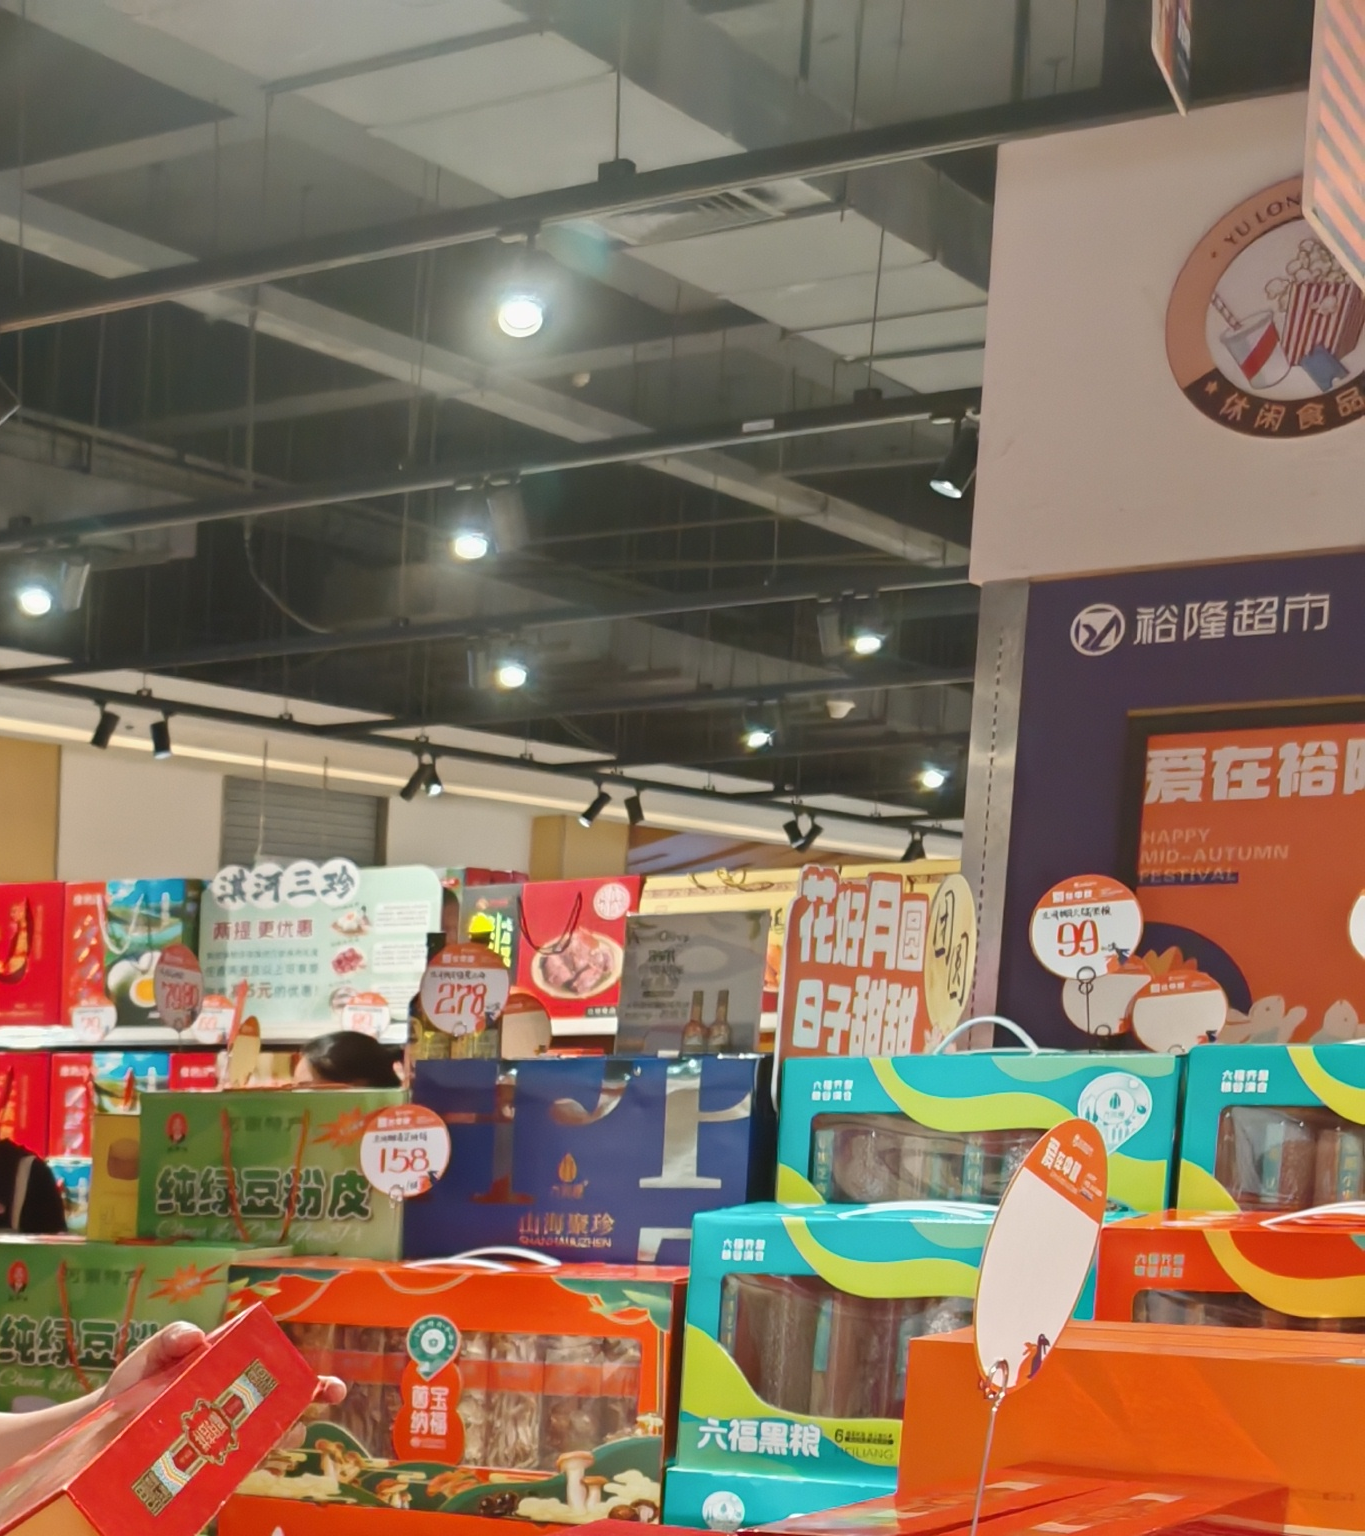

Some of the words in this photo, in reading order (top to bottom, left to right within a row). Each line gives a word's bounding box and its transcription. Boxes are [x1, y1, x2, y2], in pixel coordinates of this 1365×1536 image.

[1133, 593, 1331, 646] 裕隆超市
[1140, 827, 1210, 846] HAPPY
[217, 865, 356, 903] 淇河三珍
[797, 867, 926, 974] 花好月圆
[1056, 918, 1100, 958] 99
[433, 981, 488, 1016] 278
[790, 974, 920, 1058] 日子甜甜
[378, 1146, 431, 1174] 158
[155, 1165, 372, 1221] 纯绿豆粉皮
[696, 1418, 821, 1459] 六福黑粮
